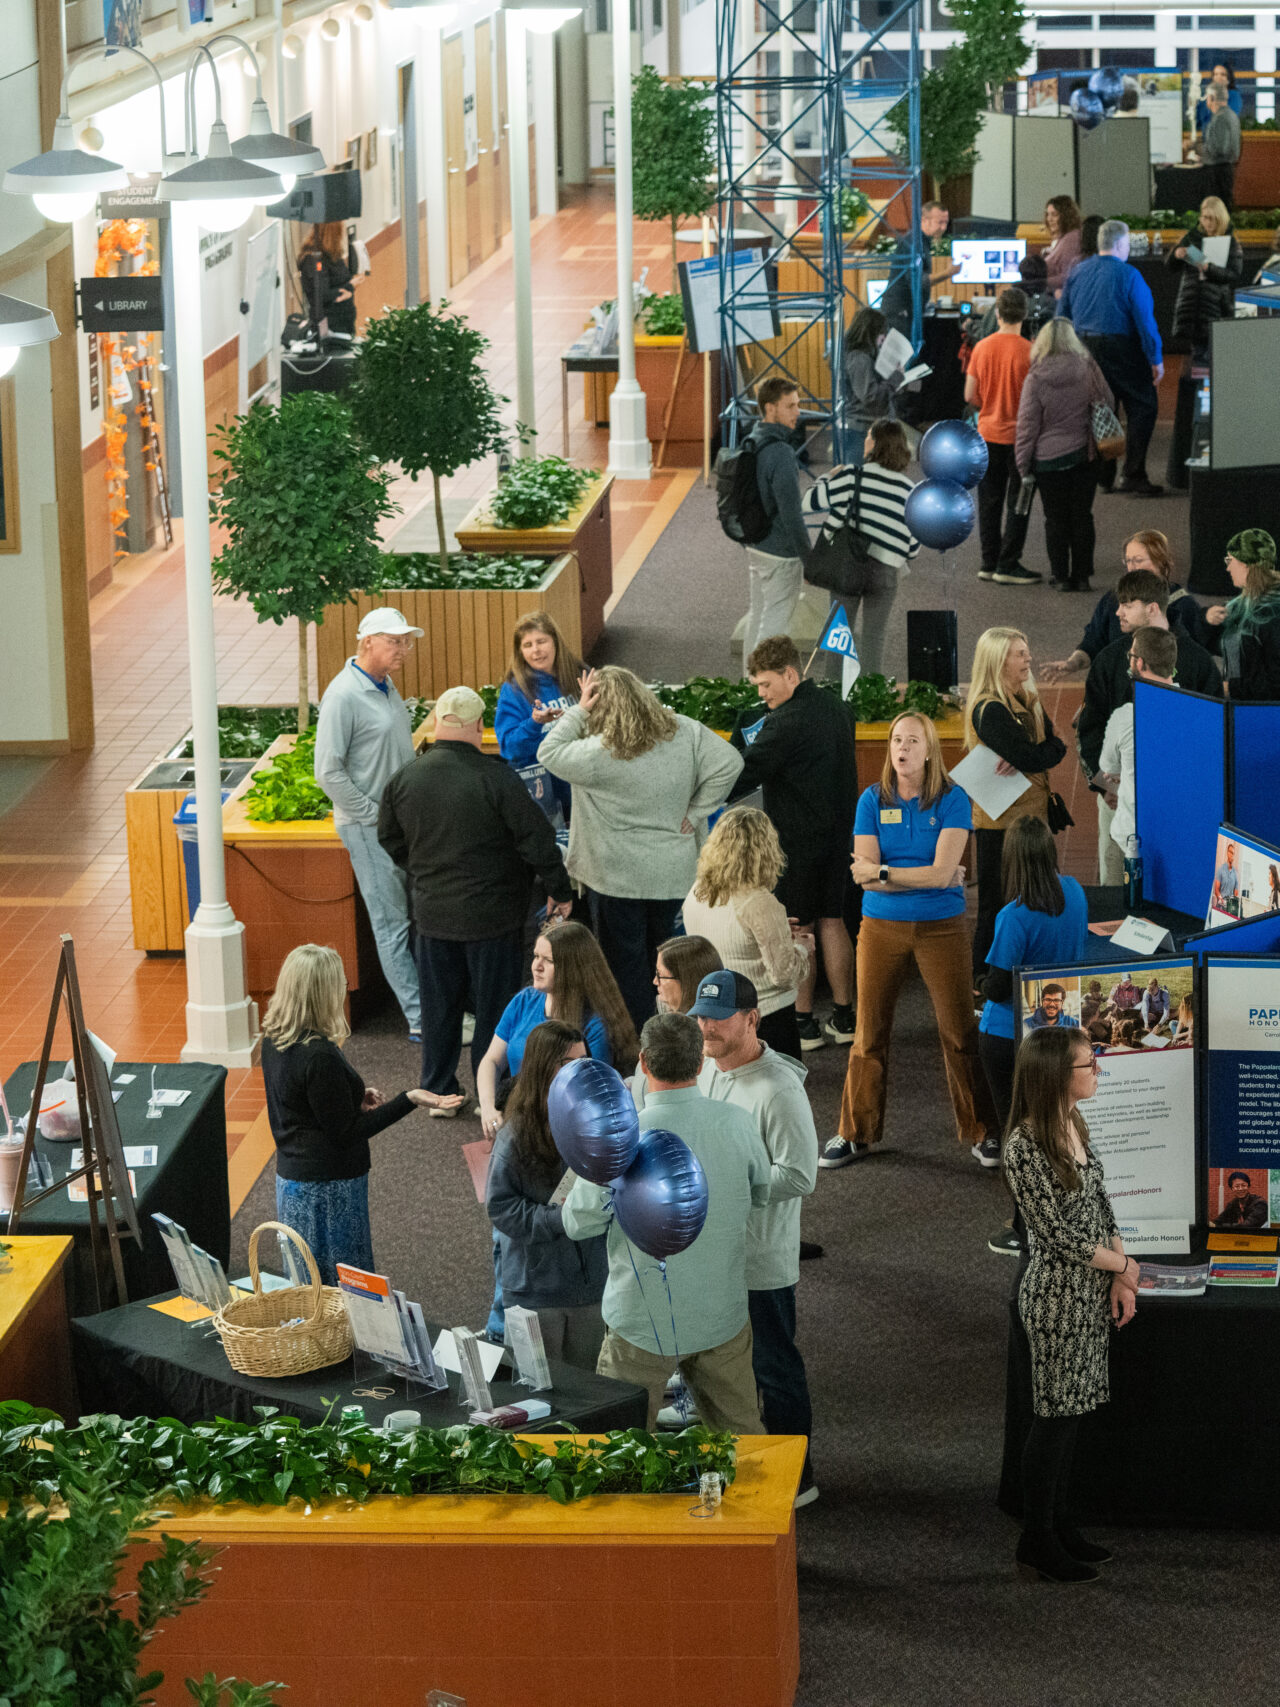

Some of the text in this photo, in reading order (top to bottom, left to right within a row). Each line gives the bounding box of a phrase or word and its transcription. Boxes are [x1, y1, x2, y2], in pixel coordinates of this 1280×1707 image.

[109, 300, 148, 311] LIBRARY
[827, 628, 850, 651] GO
[1120, 1235, 1159, 1243] Pappalardo
[341, 1274, 368, 1288] Programs
